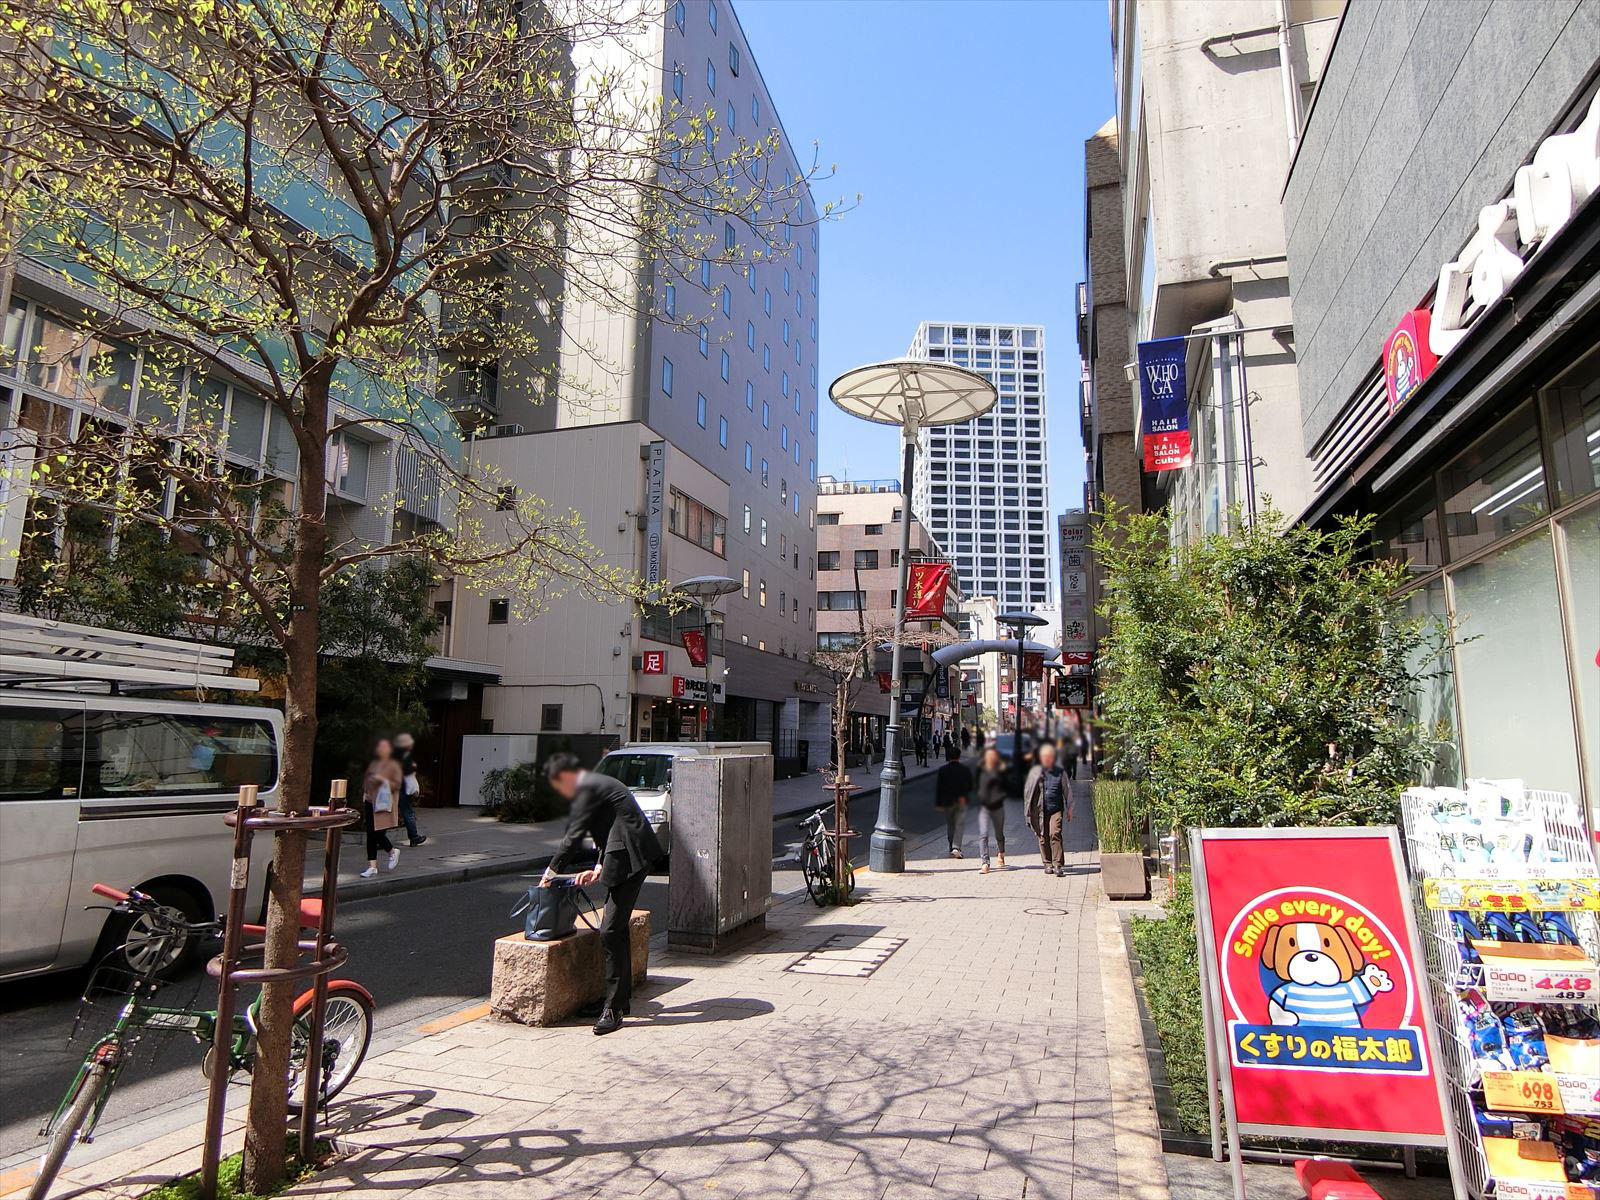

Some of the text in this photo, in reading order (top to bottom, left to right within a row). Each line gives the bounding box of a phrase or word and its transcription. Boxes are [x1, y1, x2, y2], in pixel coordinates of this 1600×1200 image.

[1146, 363, 1179, 383] WHO
[1151, 376, 1174, 396] GA
[1152, 418, 1178, 426] HAIR
[1152, 424, 1179, 432] SALON
[1153, 442, 1180, 450] NAIL
[1154, 449, 1180, 457] SALON
[1155, 456, 1181, 465] cube
[651, 448, 662, 515] PLATINA
[1062, 528, 1083, 536] Color
[646, 654, 660, 671] 足
[1280, 899, 1344, 926] every
[1345, 916, 1391, 960] day!
[1535, 977, 1592, 991] 448
[1555, 991, 1586, 1000] 483
[1239, 1032, 1413, 1064] くすりの福太郎
[1522, 1081, 1554, 1100] 698
[1534, 1100, 1553, 1109] 753
